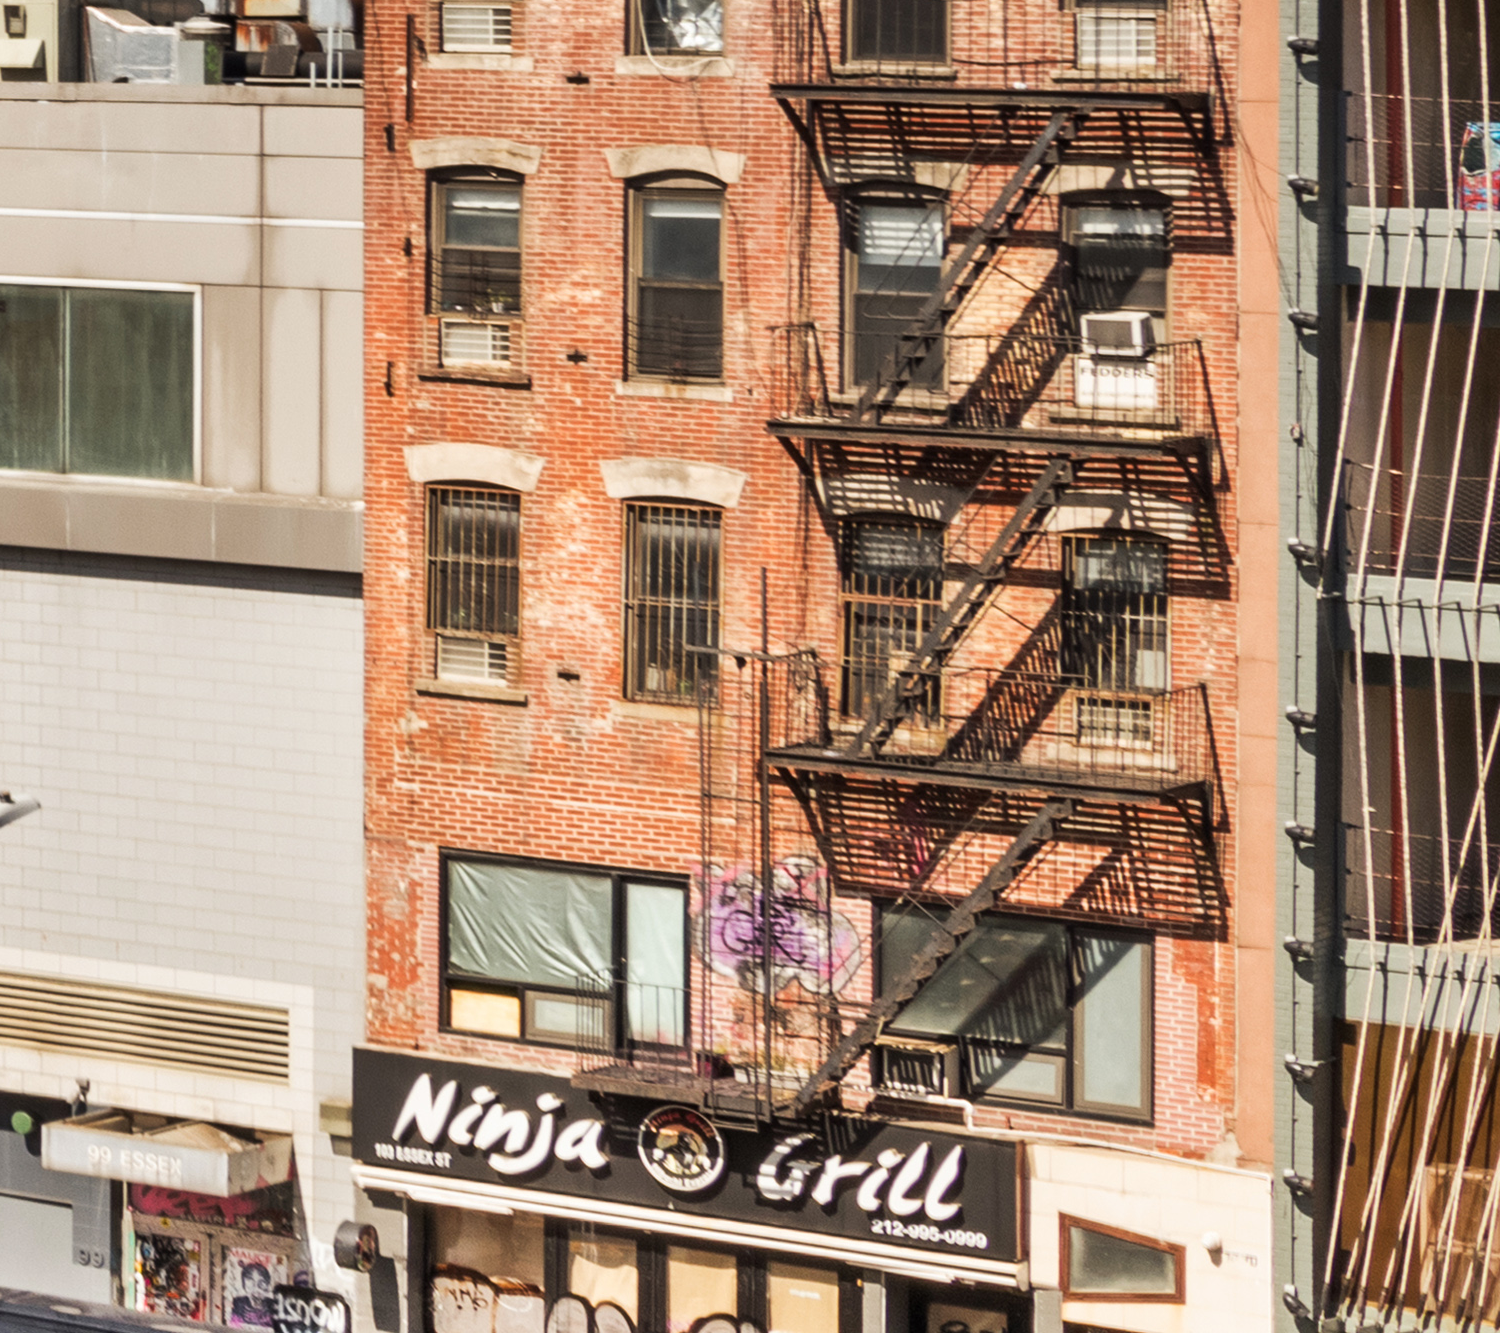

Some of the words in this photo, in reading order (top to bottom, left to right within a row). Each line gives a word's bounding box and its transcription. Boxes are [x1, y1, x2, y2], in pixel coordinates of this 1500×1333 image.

[87, 1144, 113, 1165] 99
[119, 1148, 183, 1177] ESSEX
[392, 1072, 612, 1176] Ninja
[755, 1132, 964, 1222] Grill
[395, 1146, 437, 1167] ESSEX
[437, 1150, 454, 1169] ST
[77, 1249, 105, 1269] 99
